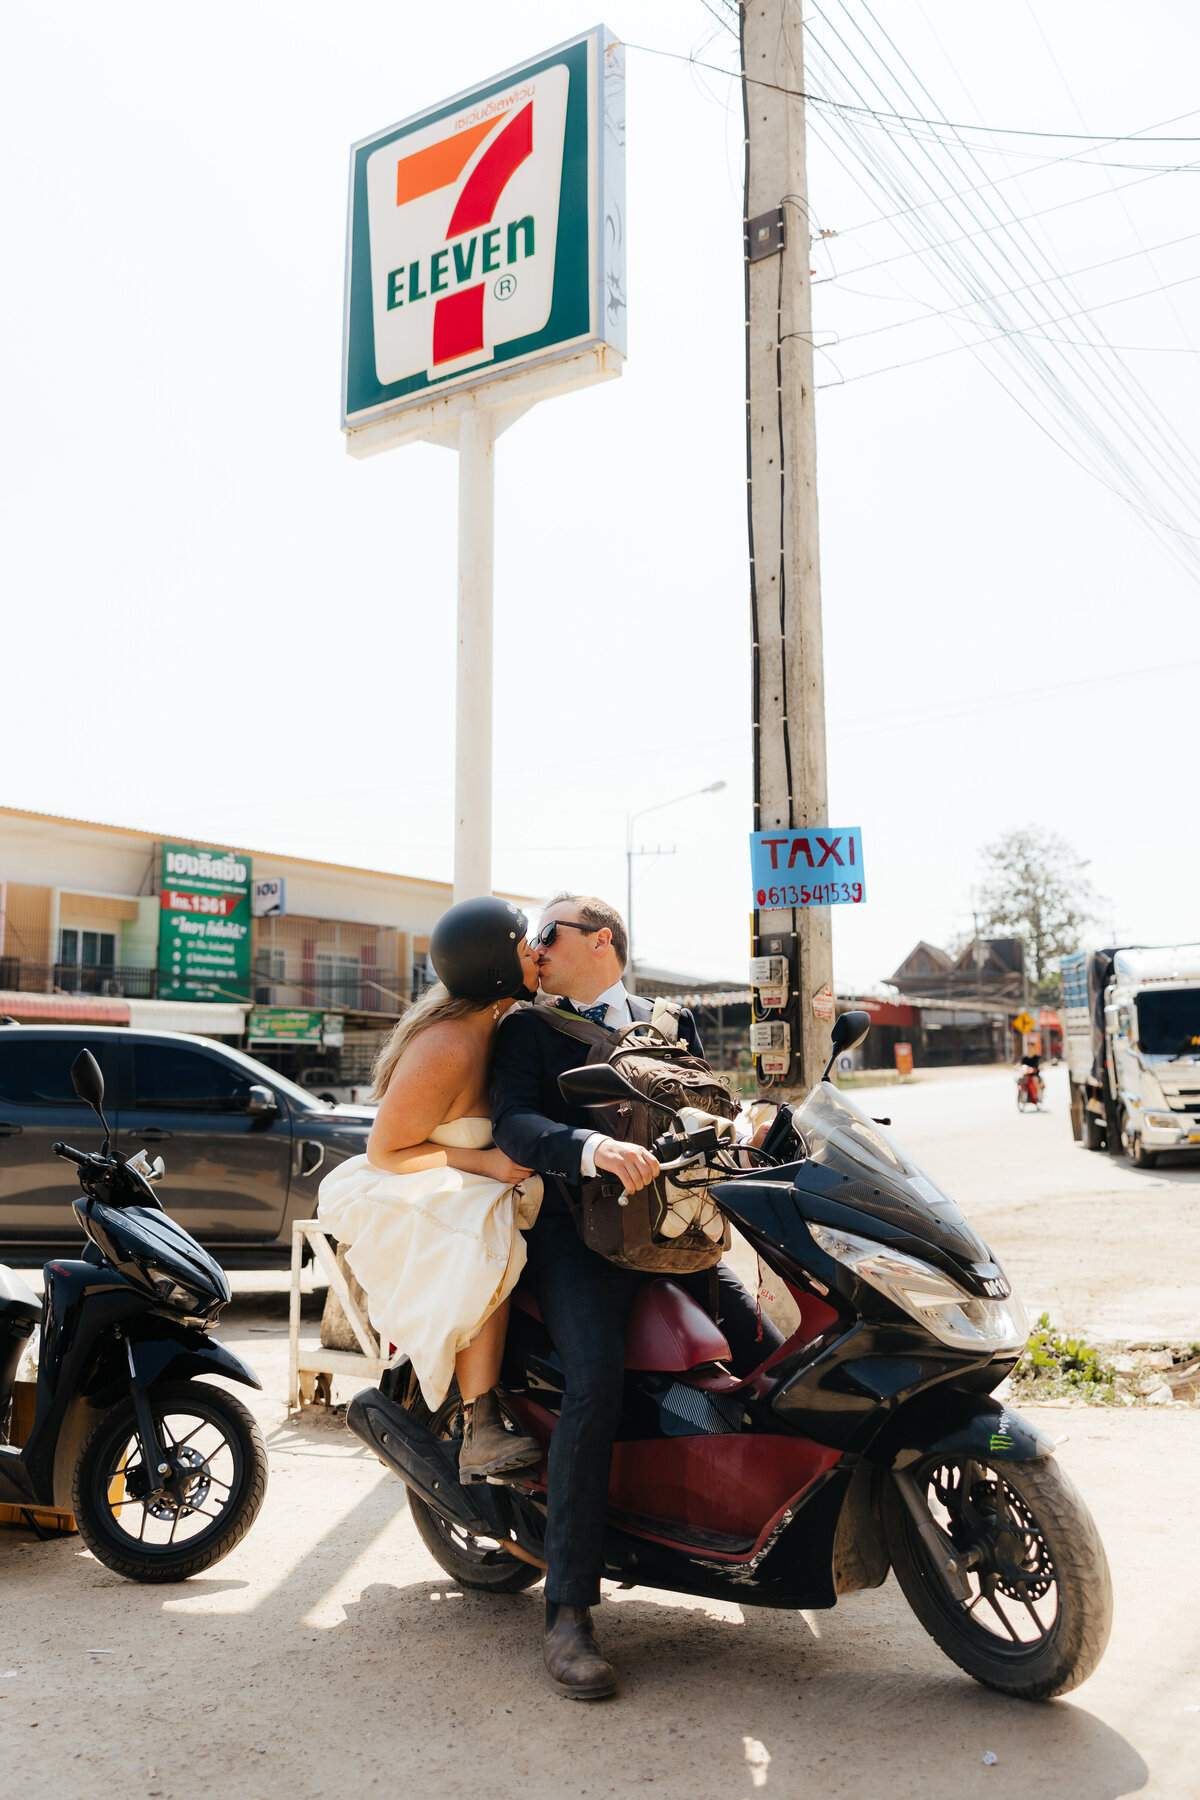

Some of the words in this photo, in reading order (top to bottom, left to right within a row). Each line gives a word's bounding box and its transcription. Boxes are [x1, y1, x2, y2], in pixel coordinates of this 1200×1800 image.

[397, 100, 533, 367] 7
[761, 837, 855, 869] TAXI
[756, 882, 863, 906] 0613541539
